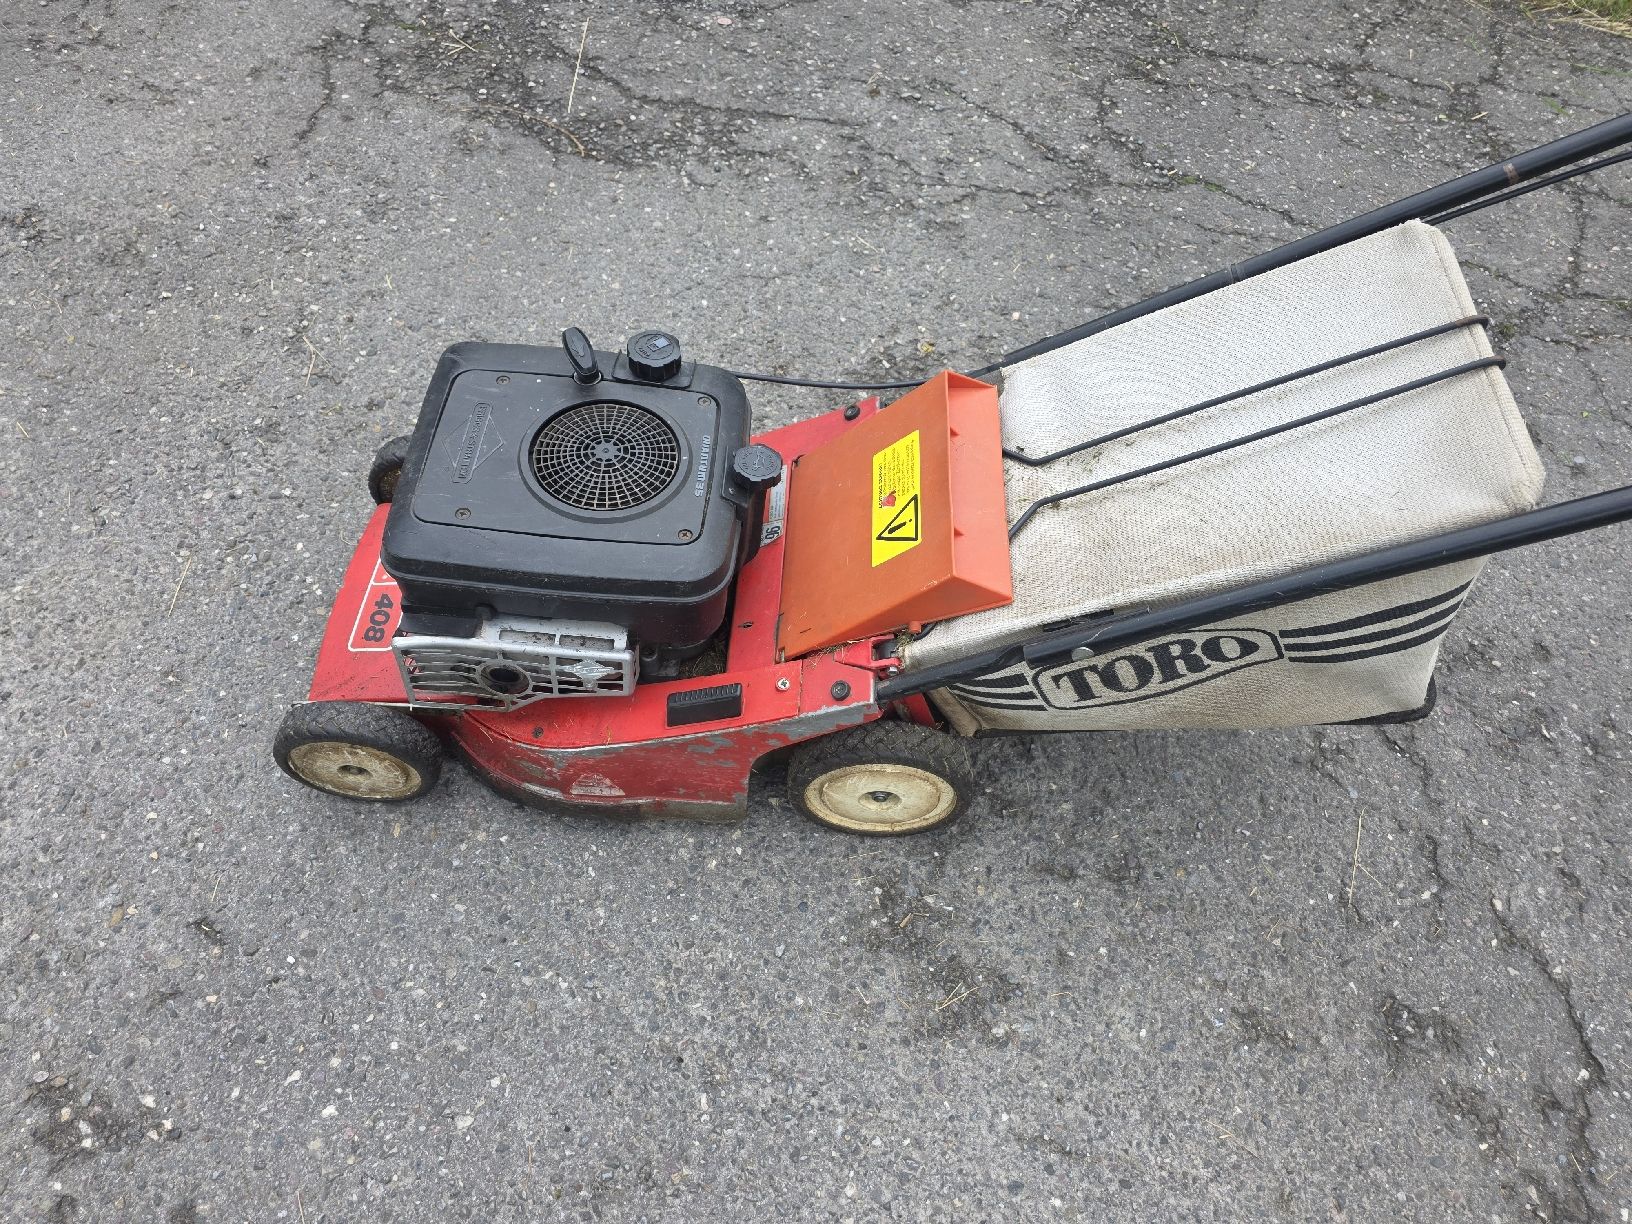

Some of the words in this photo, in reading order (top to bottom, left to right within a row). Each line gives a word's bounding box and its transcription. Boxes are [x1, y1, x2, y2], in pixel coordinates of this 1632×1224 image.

[764, 525, 781, 540] 96
[363, 593, 394, 643] 408
[1052, 634, 1260, 703] TORO
